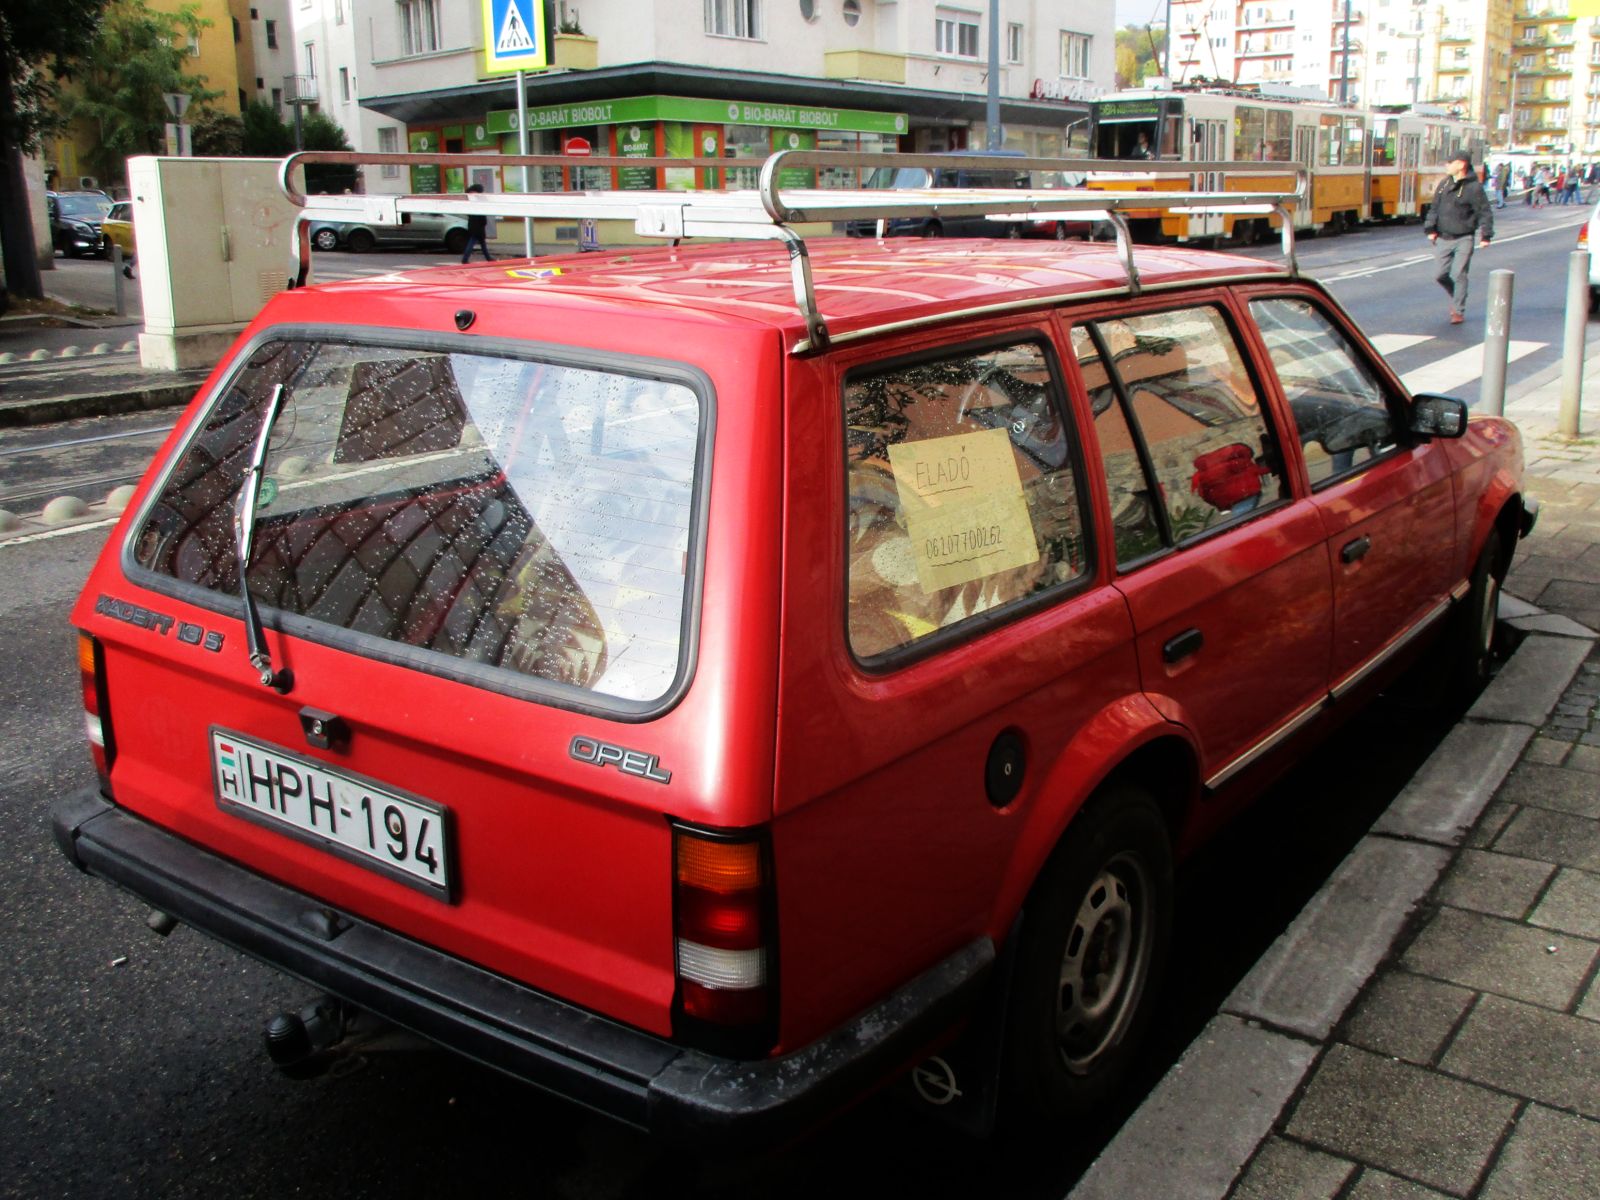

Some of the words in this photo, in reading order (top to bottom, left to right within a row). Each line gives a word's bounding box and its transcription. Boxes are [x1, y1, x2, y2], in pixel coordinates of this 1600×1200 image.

[527, 107, 568, 127] IO-BARÁT
[572, 105, 612, 123] BIOBOLT
[743, 105, 796, 123] BIO-BARÁT
[800, 111, 838, 126] BIOBOLT
[916, 446, 970, 490] ELADÓ
[96, 595, 174, 635] KADETT
[570, 736, 670, 783] OPEL
[222, 769, 239, 796] H
[247, 753, 438, 874] HPH-194
